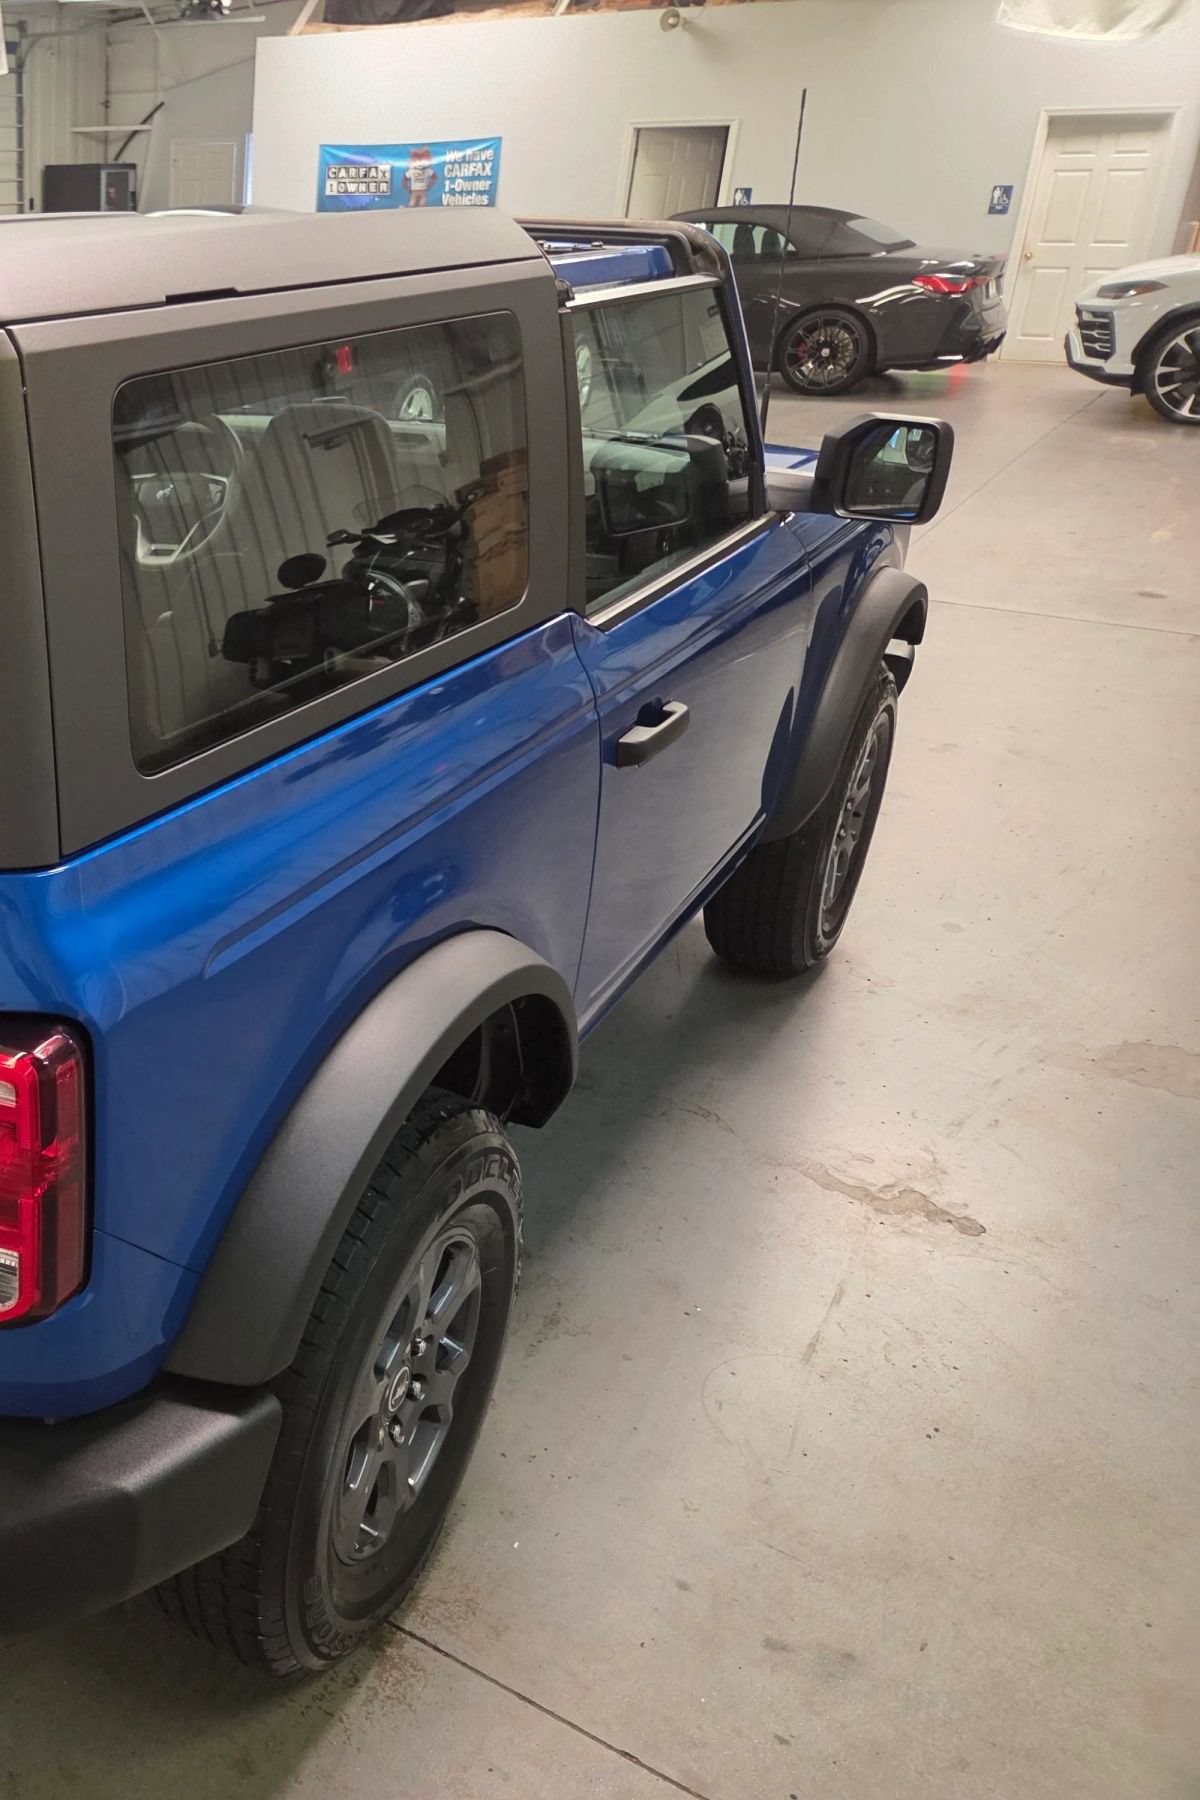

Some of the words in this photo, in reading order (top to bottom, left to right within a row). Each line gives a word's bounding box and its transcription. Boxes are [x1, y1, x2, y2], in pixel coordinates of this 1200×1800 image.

[445, 149, 463, 162] We
[465, 149, 494, 161] have
[328, 167, 389, 179] CARFAX
[444, 162, 492, 178] CARFAX
[444, 178, 492, 192] 1-Owner
[441, 193, 489, 206] Vehicles
